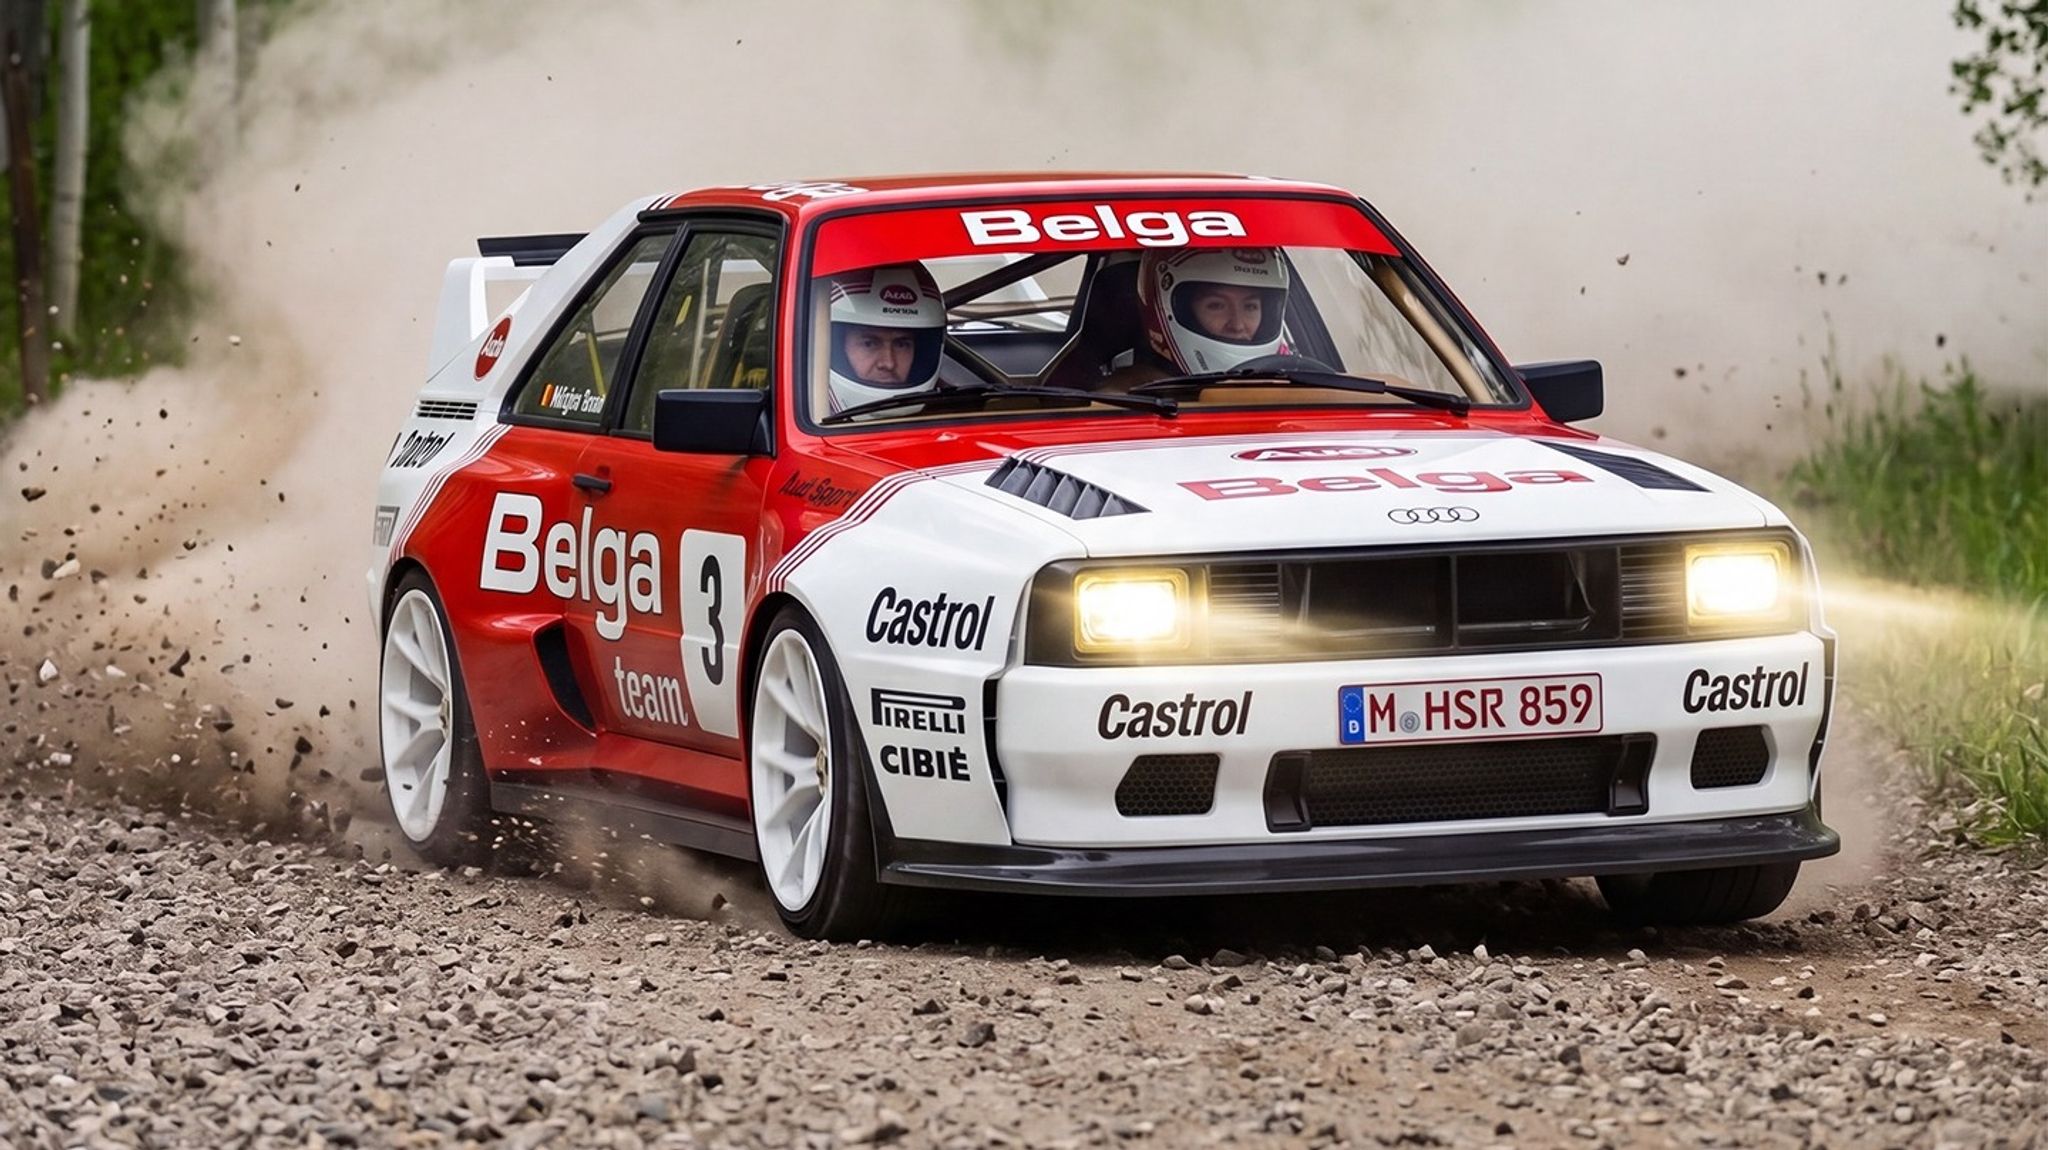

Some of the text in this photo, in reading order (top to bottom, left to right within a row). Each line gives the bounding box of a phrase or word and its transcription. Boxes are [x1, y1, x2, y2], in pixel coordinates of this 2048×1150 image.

[960, 205, 1247, 247] Belga
[1177, 468, 1595, 501] Belga
[479, 492, 663, 641] Belga
[700, 555, 724, 686] 3
[866, 587, 996, 651] Castrol
[614, 656, 689, 727] team
[870, 687, 966, 735] PIRELLI
[1369, 683, 1593, 734] M HSR 859
[1683, 661, 1809, 714] Castrol
[1098, 690, 1254, 740] Castrol
